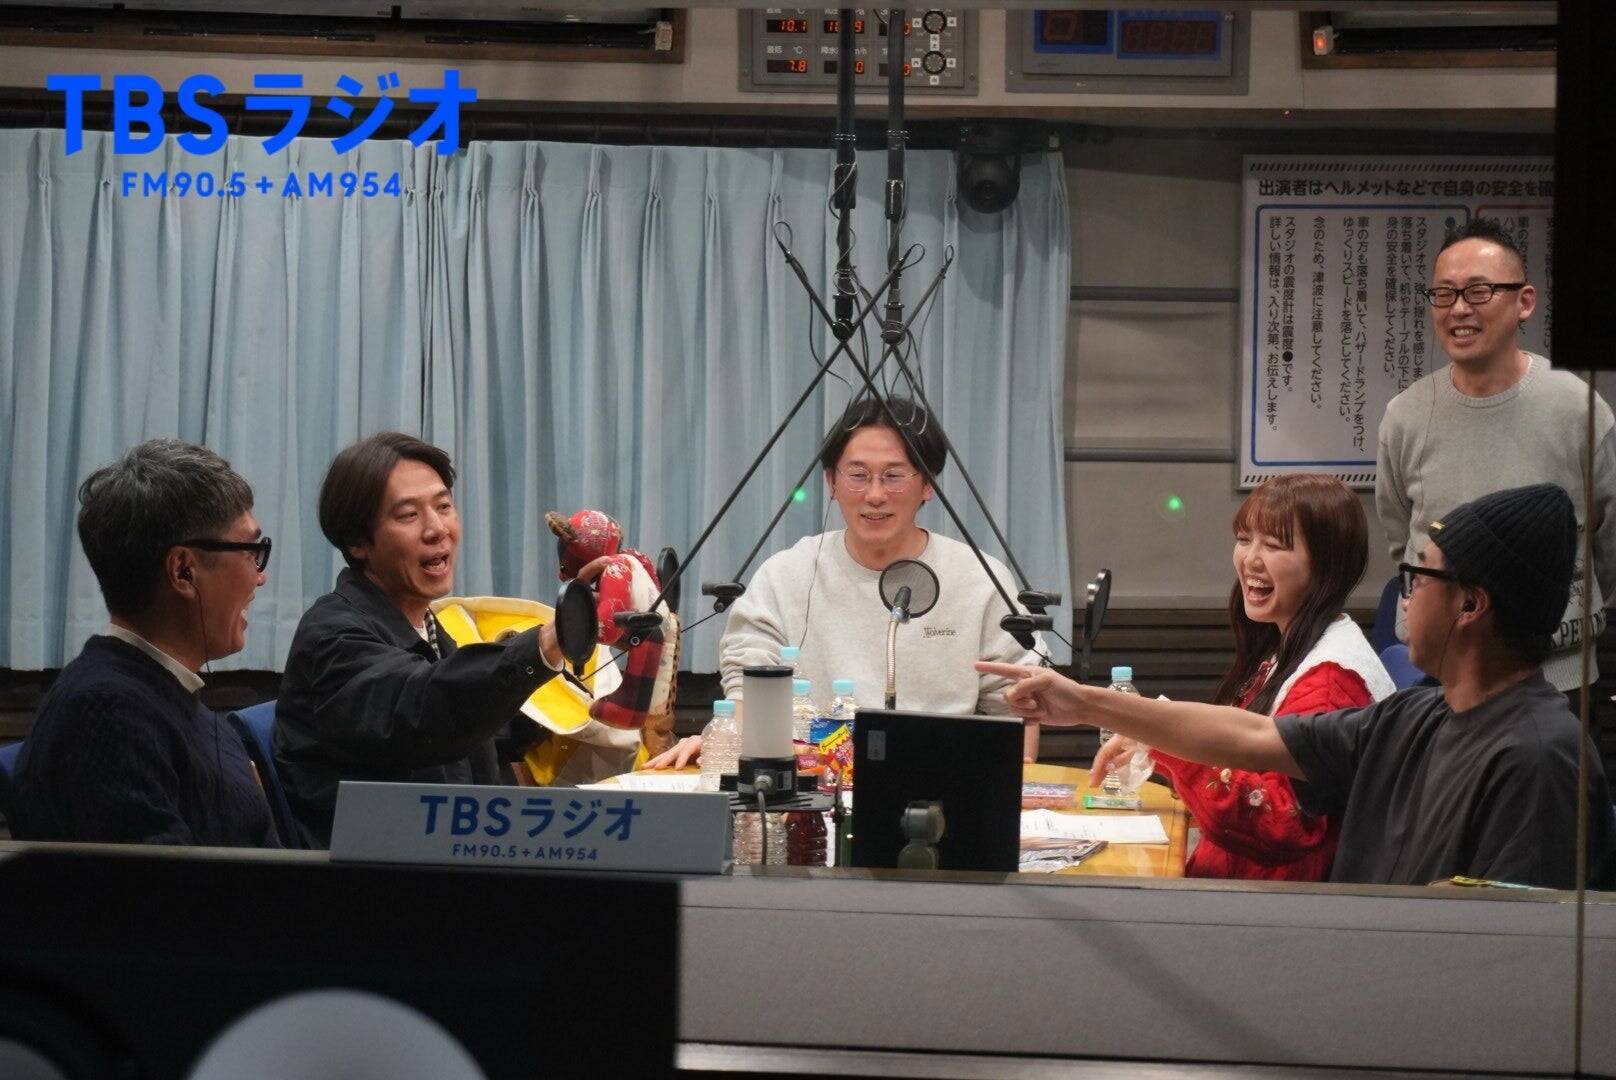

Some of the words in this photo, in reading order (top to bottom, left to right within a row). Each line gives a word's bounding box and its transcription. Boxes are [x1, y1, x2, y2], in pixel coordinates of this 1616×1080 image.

[781, 20, 807, 32] 10.1
[419, 794, 642, 842] TBSラジオ
